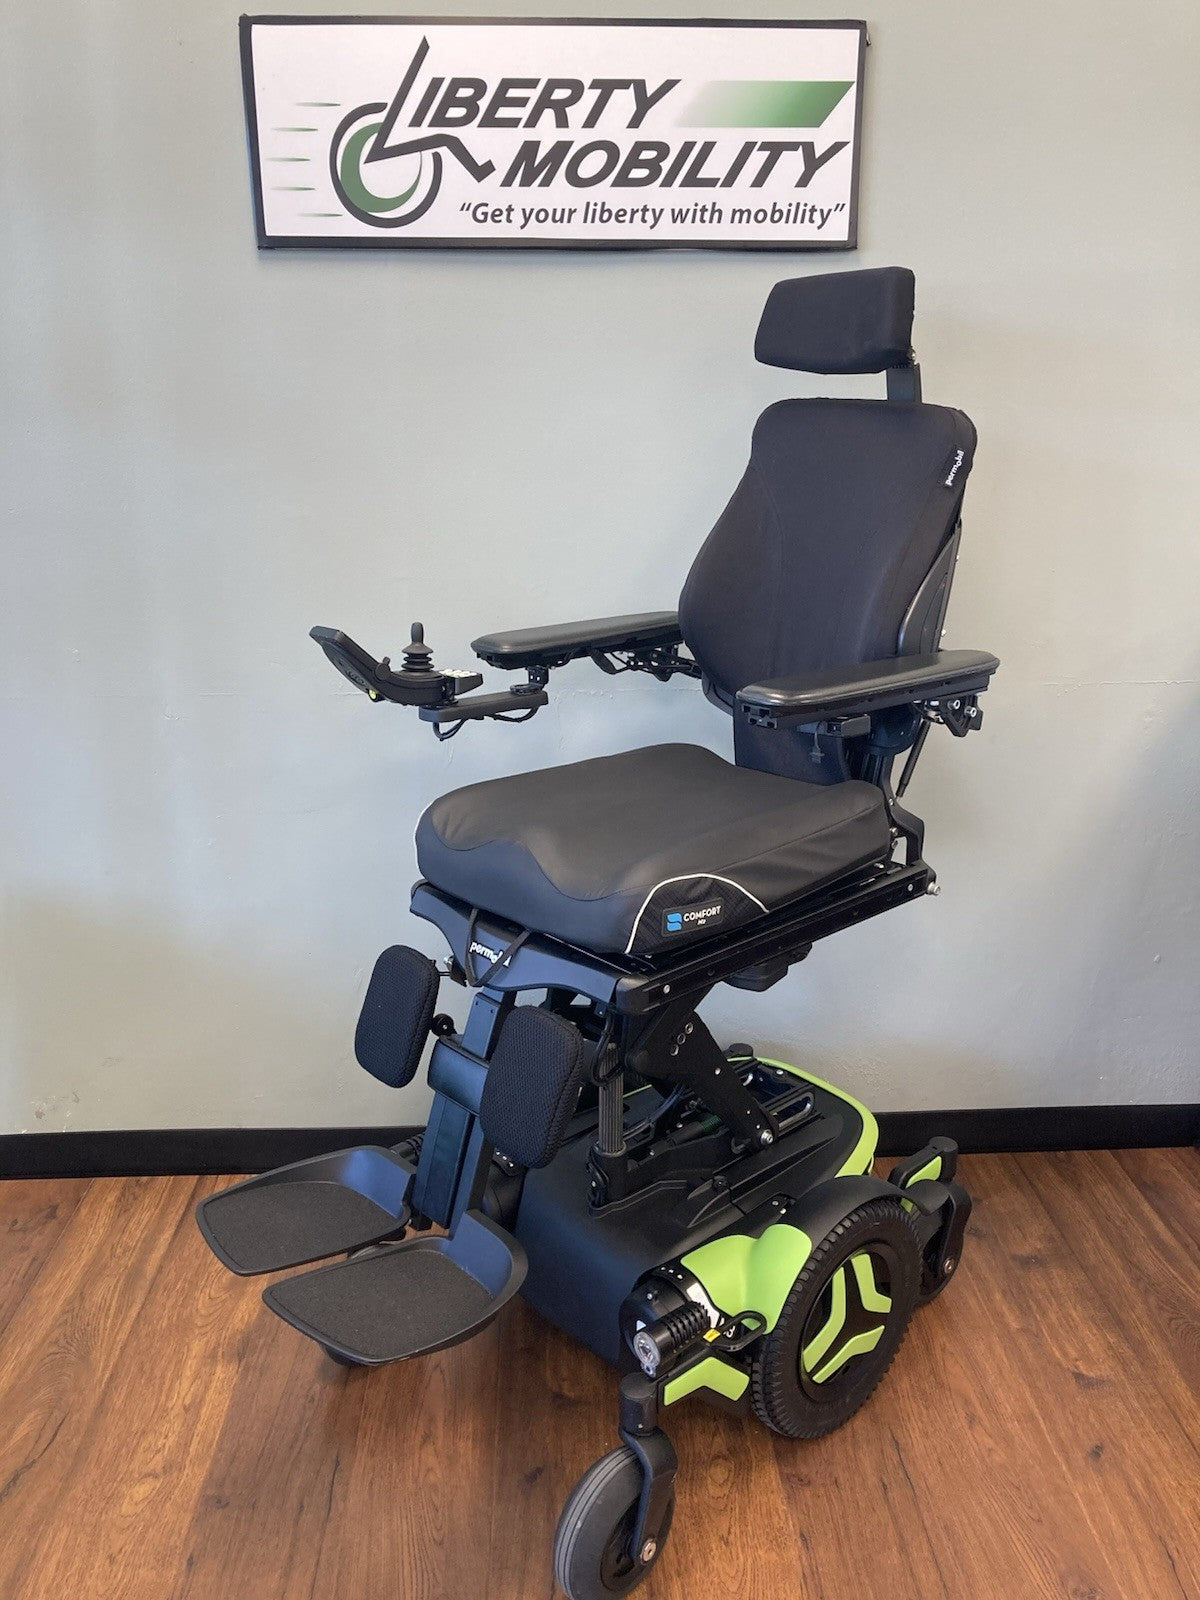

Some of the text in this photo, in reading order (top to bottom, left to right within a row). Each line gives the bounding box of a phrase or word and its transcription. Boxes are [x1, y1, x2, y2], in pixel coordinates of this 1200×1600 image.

[499, 140, 850, 188] MOBILITY
[520, 207, 577, 230] your
[582, 201, 664, 230] liberty
[671, 201, 723, 224] with
[945, 449, 965, 487] permobil
[683, 905, 722, 922] COMFORT
